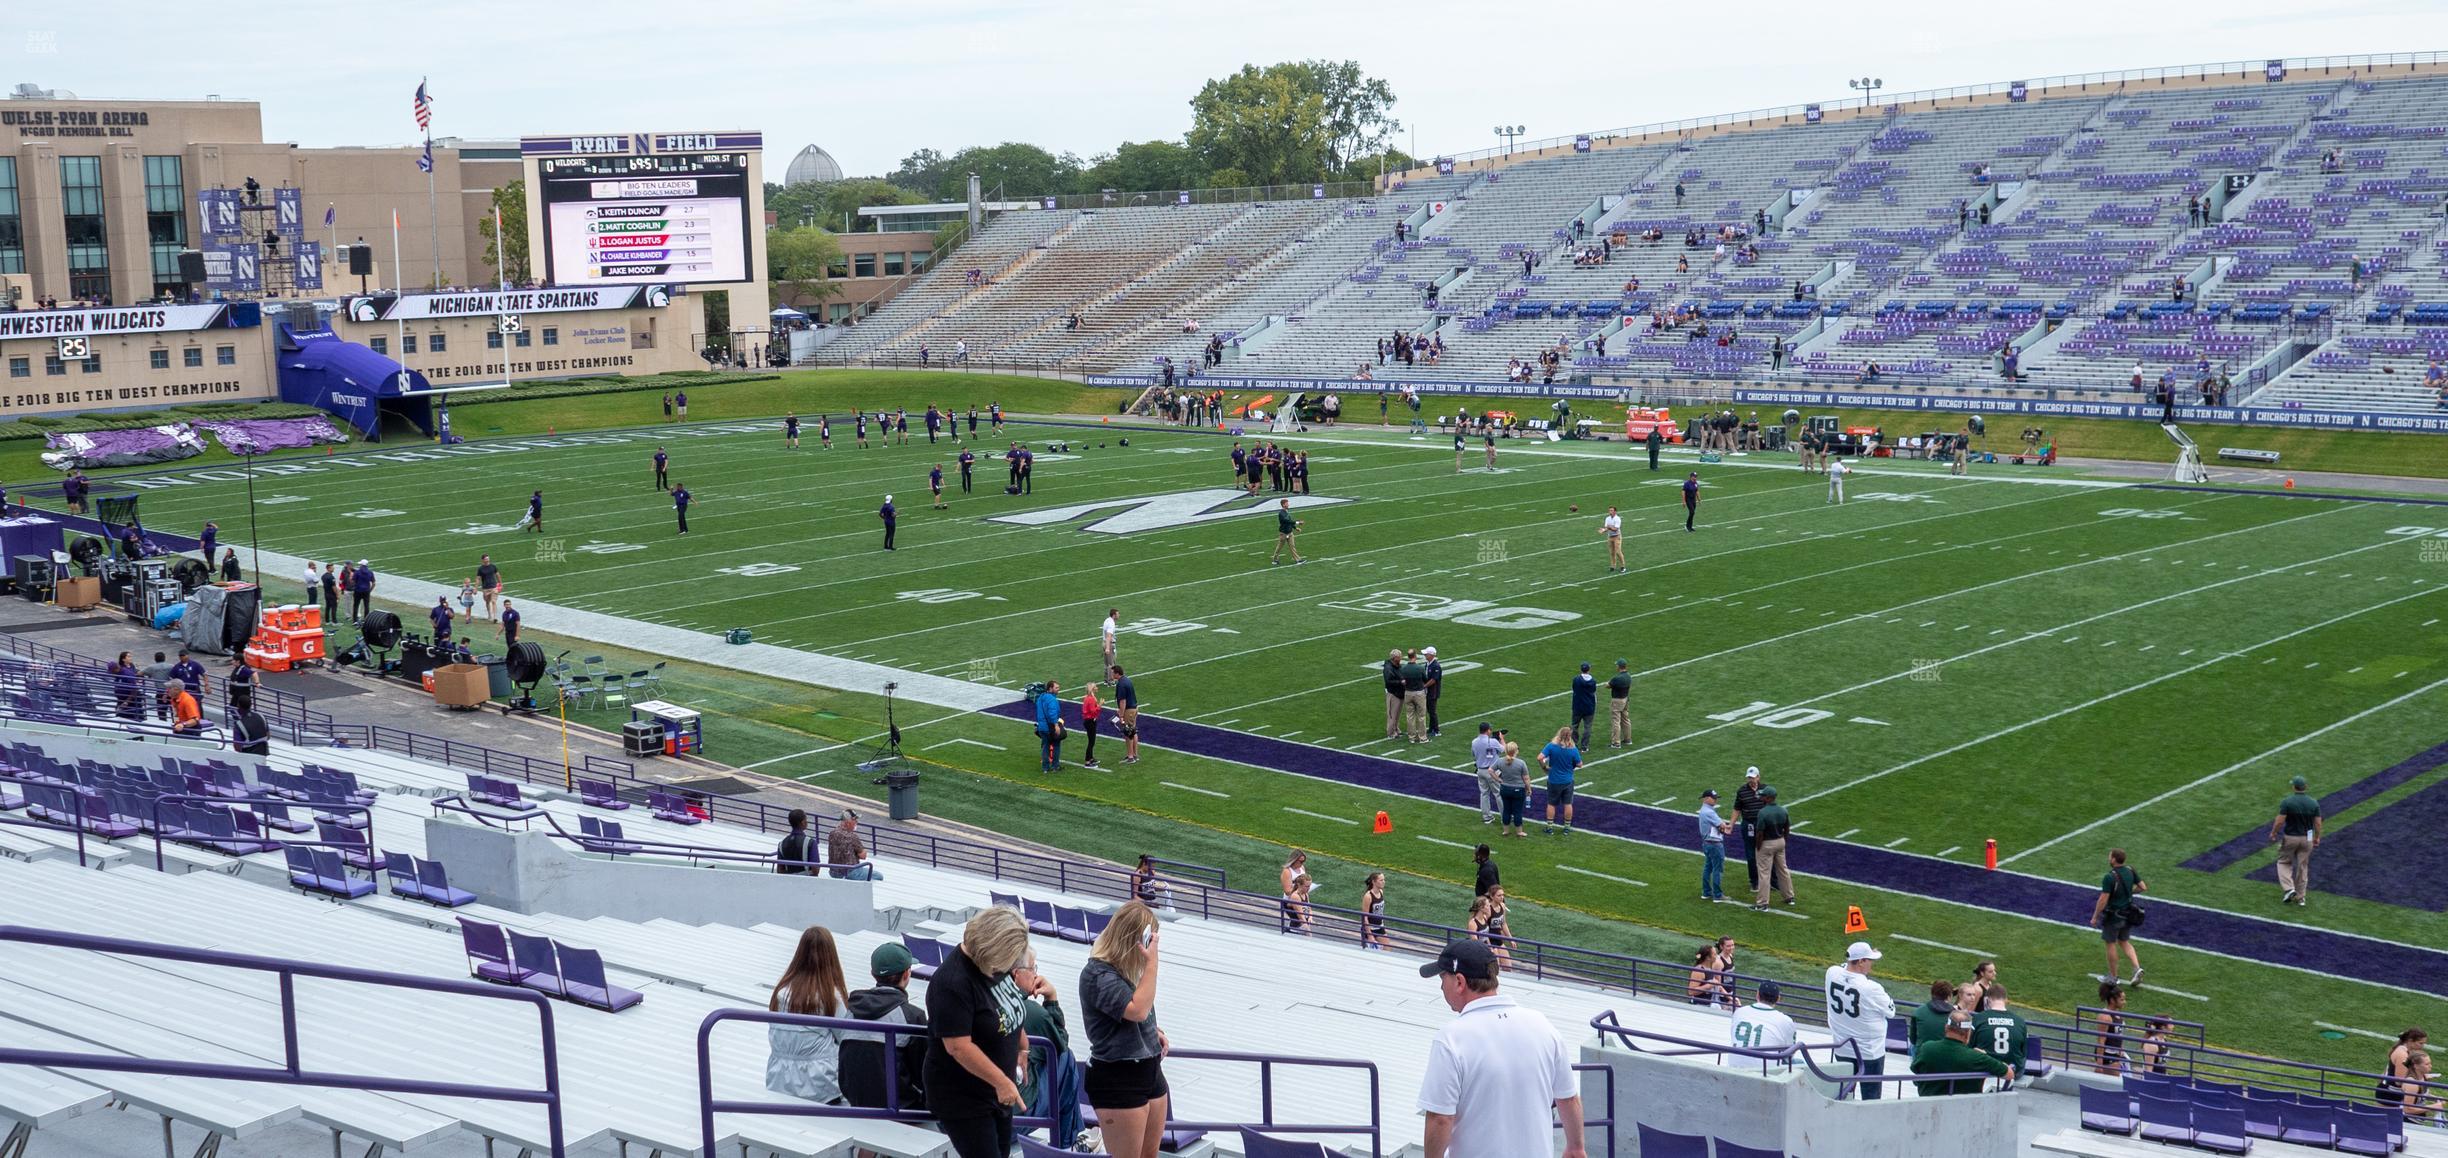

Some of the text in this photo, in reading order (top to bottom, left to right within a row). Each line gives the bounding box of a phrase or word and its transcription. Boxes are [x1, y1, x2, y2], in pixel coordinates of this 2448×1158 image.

[1, 111, 148, 126] WELSH-RYAN ARENA
[58, 127, 107, 136] MEMORIAL
[110, 128, 134, 136] HALL
[571, 138, 618, 154] RYAN
[666, 135, 716, 151] FIELD
[546, 160, 554, 172] 0
[740, 156, 746, 168] 0
[218, 202, 235, 224] N
[280, 201, 296, 223] N
[605, 208, 626, 216] KEITH
[238, 256, 254, 279] N
[300, 255, 316, 278] N
[608, 266, 656, 275] JAKE MOODY
[430, 296, 493, 314] MICHIGAN
[538, 292, 598, 308] SPARTANS
[0, 310, 164, 335] HWESTERN WILDCATS
[63, 338, 86, 356] 25
[428, 368, 450, 378] THE
[456, 365, 482, 376] 2018
[487, 364, 505, 374] BIG
[511, 362, 532, 372] TEN
[537, 360, 567, 370] WEST
[572, 356, 633, 368] CHAMPIONS
[17, 394, 50, 406] 2018
[56, 391, 80, 403] BIG
[86, 389, 112, 401] TEN
[119, 386, 158, 399] WEST
[164, 381, 240, 396] CHAMPIONS
[1748, 393, 1778, 401] CHICAGO'S
[1790, 394, 1802, 402] TEN
[1804, 394, 1821, 402] TEAM
[1839, 396, 1871, 404] CHICAGO'S
[1872, 397, 1882, 405] BIG
[1884, 397, 1896, 405] TEN
[1898, 398, 1916, 406] TEAM
[1934, 399, 1968, 408] CHICAGO'S
[1969, 400, 1980, 409] BIG
[1982, 401, 1996, 409] TEN
[1997, 401, 2015, 410] TEAM
[2035, 403, 2071, 413] CHICAGO'S
[2072, 405, 2084, 413] BIG
[2086, 405, 2100, 414] TEN
[2102, 406, 2121, 415] TEAM
[2182, 409, 2194, 418] BIG
[2196, 409, 2212, 418] TEN
[2214, 410, 2234, 419] TEAM
[2256, 412, 2297, 422] CHICAGO'S
[2298, 413, 2311, 423] BIG
[2314, 414, 2330, 423] TEN
[2332, 415, 2354, 424] TEAM
[2378, 417, 2421, 428] CHICAGO'S
[2423, 419, 2437, 428] BIG
[302, 641, 314, 654] G
[1706, 702, 1835, 728] 10
[1378, 817, 1387, 826] 10
[1850, 911, 1860, 927] G
[1830, 983, 1860, 1018] 53
[1988, 1018, 2014, 1026] COUSINS
[1735, 1021, 1764, 1047] 91
[1994, 1027, 2009, 1054] 8
